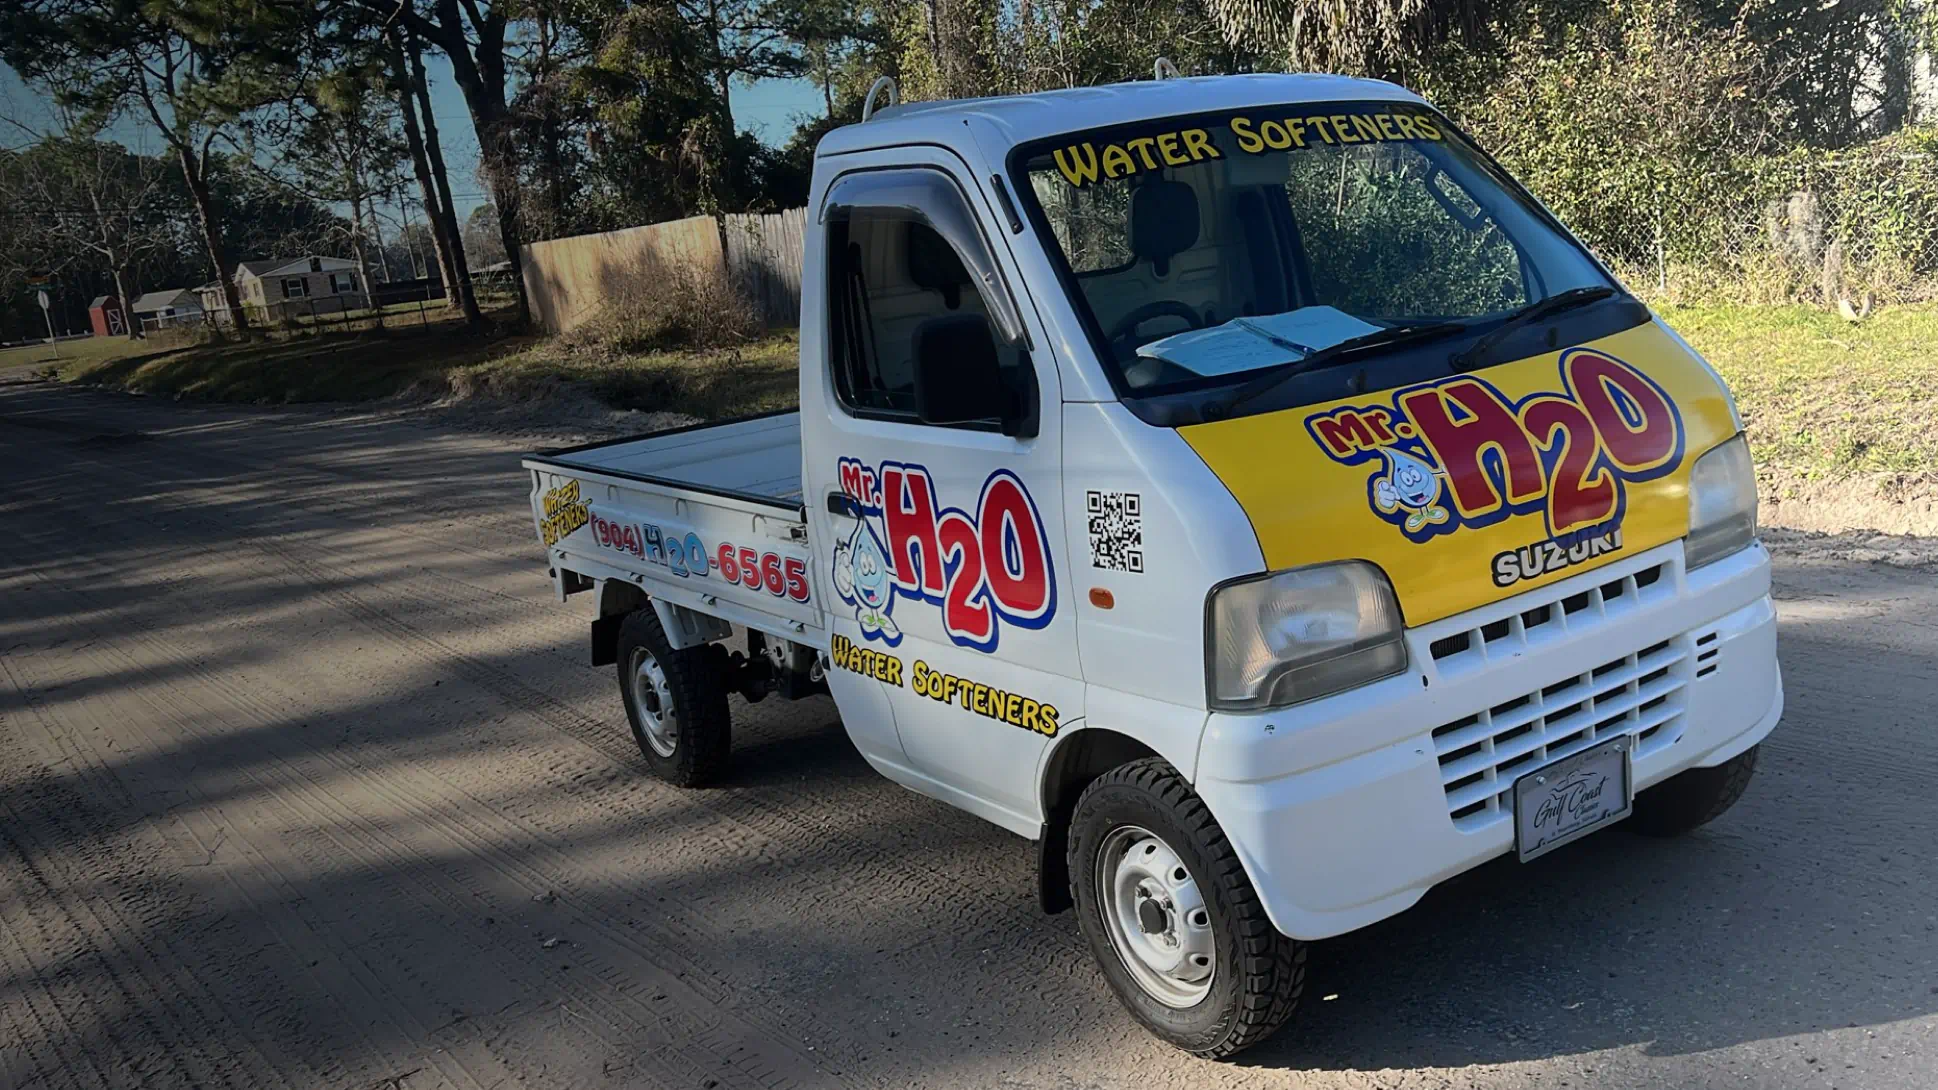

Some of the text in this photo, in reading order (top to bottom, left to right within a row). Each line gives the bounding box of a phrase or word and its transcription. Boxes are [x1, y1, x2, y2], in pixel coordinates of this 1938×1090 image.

[1052, 112, 1444, 189] WATER SOFTENERS
[1310, 350, 1680, 540] Mr. H2O
[839, 461, 1052, 646] Mr. H2O
[1491, 522, 1623, 588] SUZUKI
[832, 633, 1060, 738] WATER SOFTENERS
